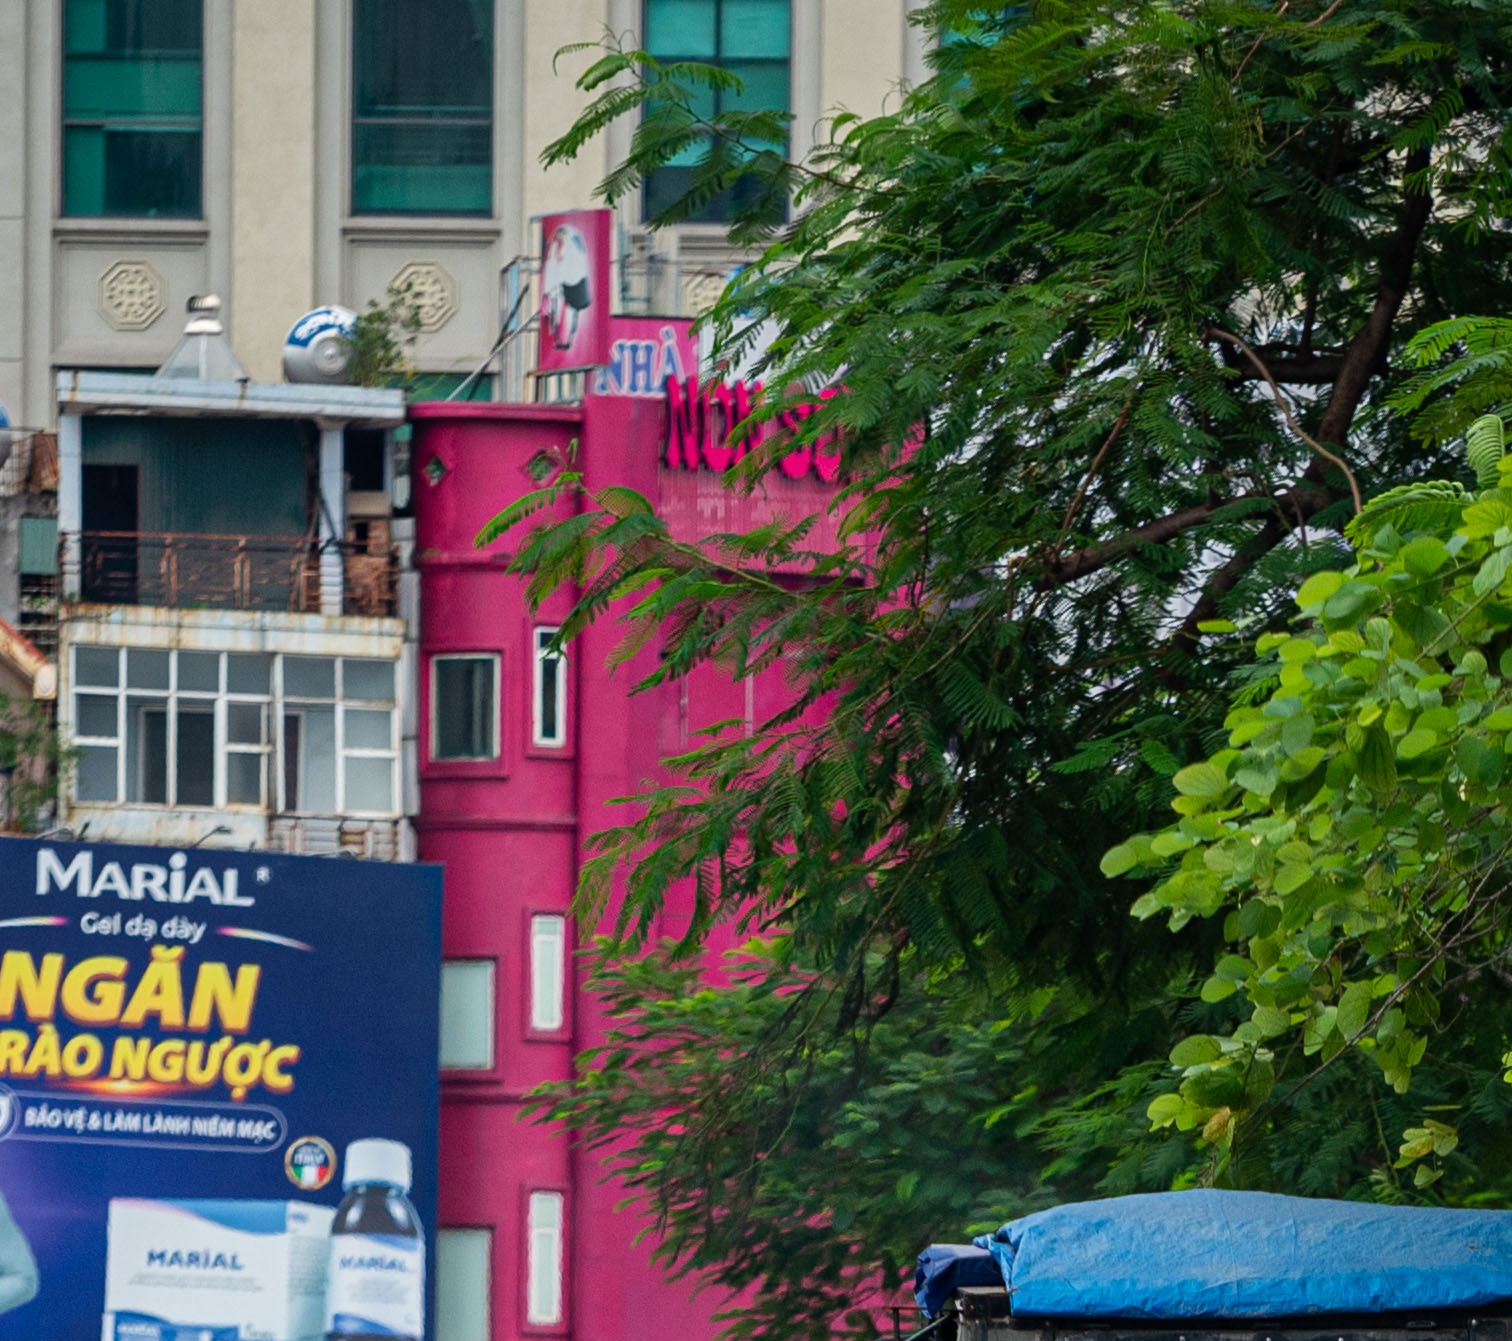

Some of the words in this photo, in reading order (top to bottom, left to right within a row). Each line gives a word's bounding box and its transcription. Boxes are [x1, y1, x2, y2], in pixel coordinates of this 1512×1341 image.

[80, 911, 121, 935] Gel
[125, 913, 158, 942] dạ
[161, 917, 208, 944] dày
[107, 1035, 301, 1103] NGƯỢC
